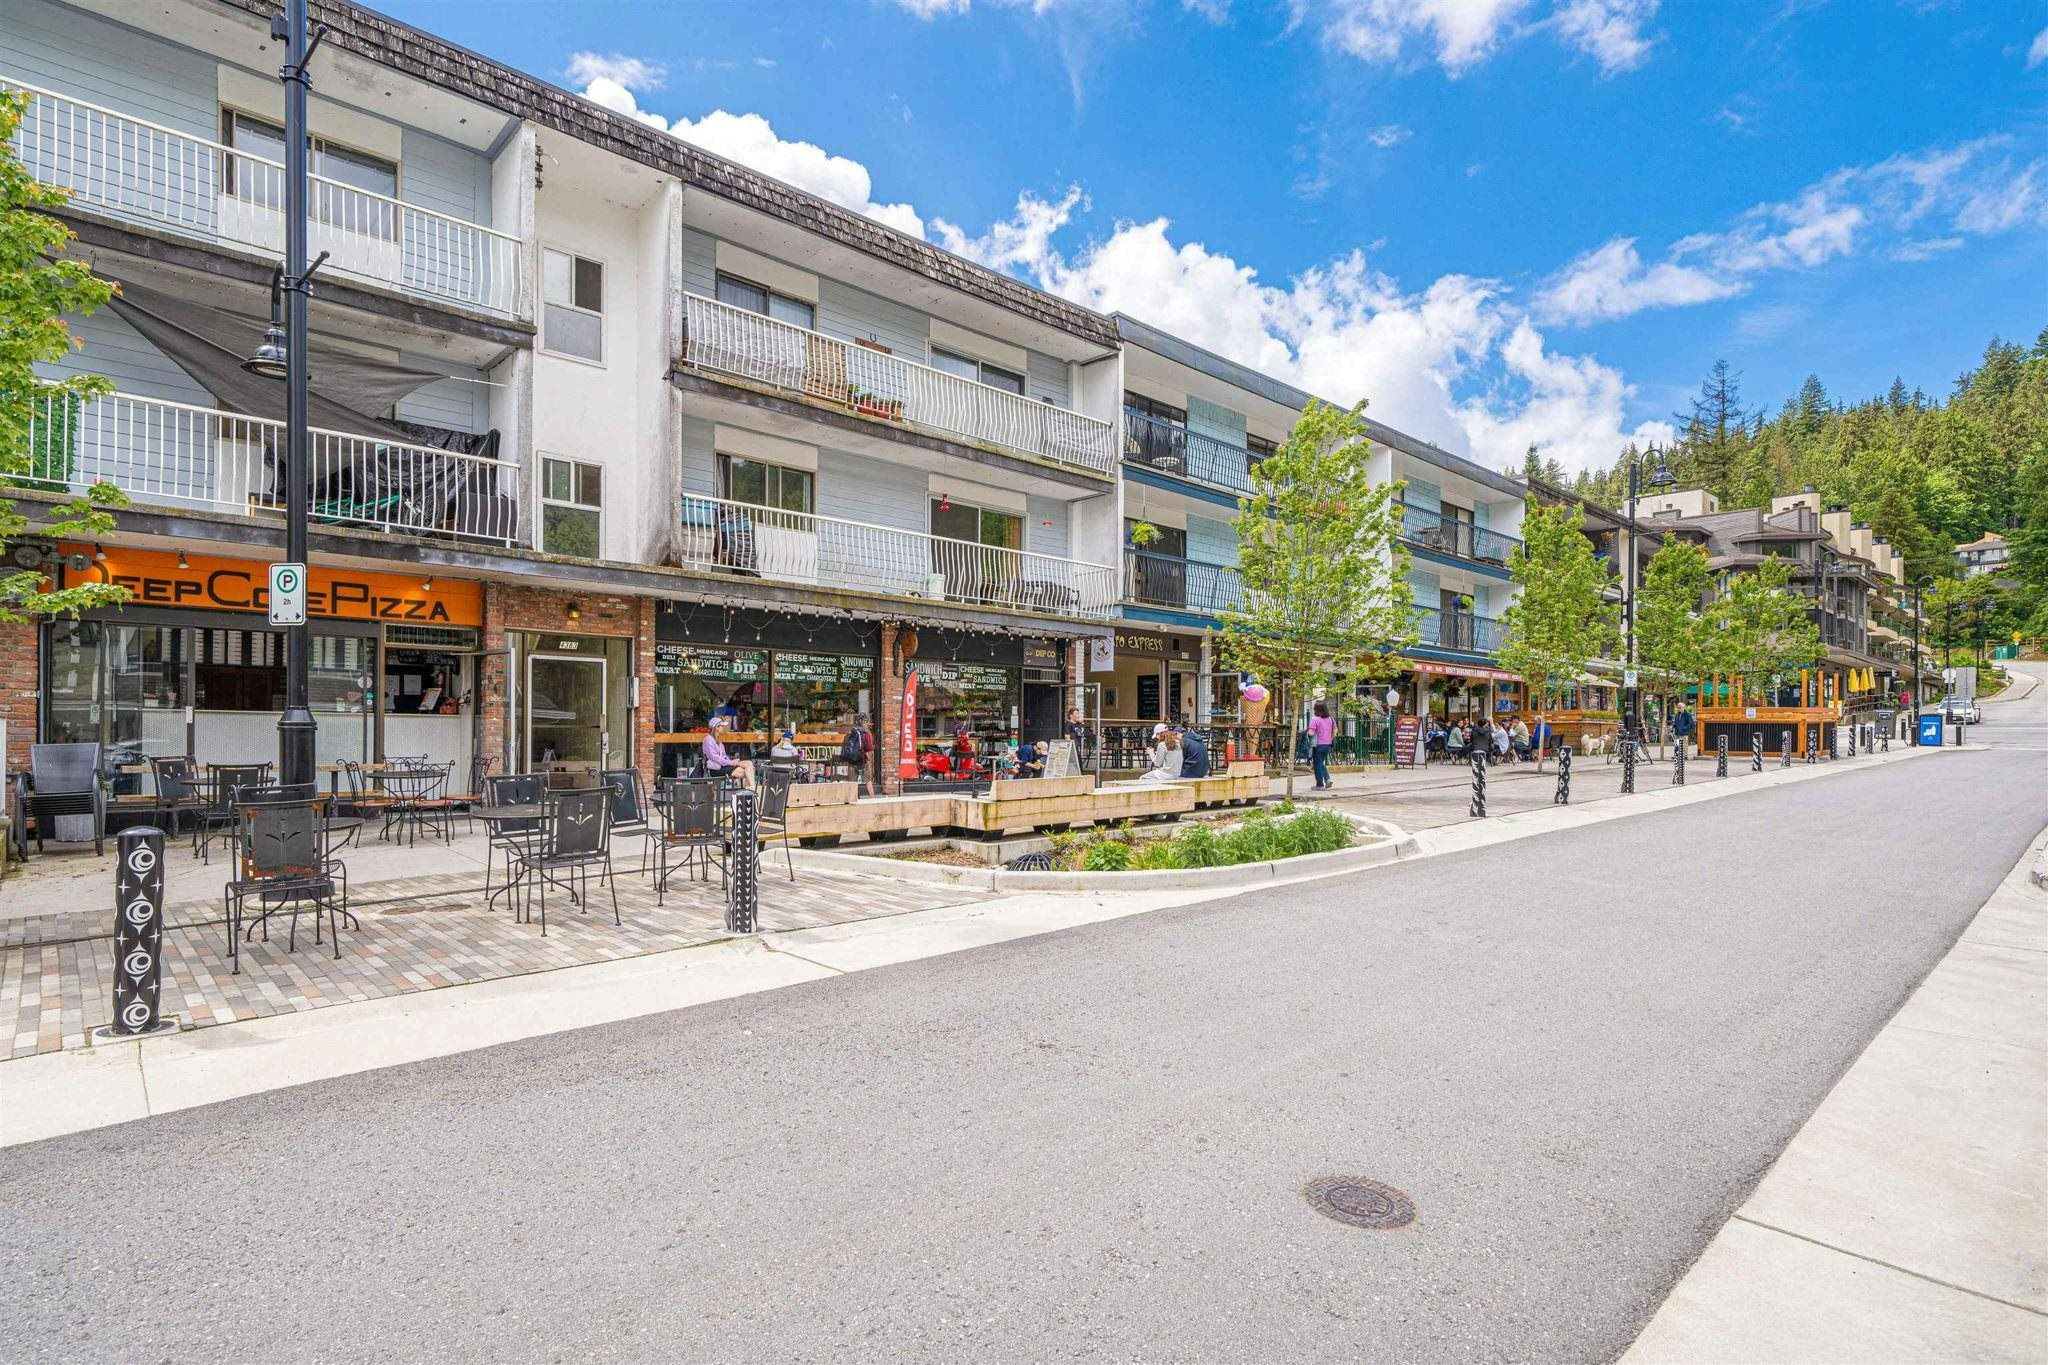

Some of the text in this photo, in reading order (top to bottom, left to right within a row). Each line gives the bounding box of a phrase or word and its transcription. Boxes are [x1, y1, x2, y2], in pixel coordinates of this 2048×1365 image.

[283, 574, 293, 588] P
[208, 569, 327, 613] COE
[331, 581, 450, 621] PIZZA
[1127, 635, 1163, 652] EXPRESS
[656, 645, 728, 656] CHEESE MERCADO
[734, 650, 759, 660] OLIVE
[1035, 649, 1056, 658] DIP CO
[775, 653, 808, 662] CHEESE
[840, 656, 874, 667] SANDWICH
[677, 657, 730, 669] SANDWICH
[905, 662, 943, 674] SANDWICH
[655, 666, 681, 674] MEAT
[733, 662, 758, 675] DIP
[793, 664, 838, 675] SANDWICH
[960, 665, 985, 674] CHEESE
[774, 672, 797, 680] MEAT
[842, 670, 868, 679] BREAD
[941, 671, 958, 679] DIP
[973, 675, 1007, 684] SANDWICH
